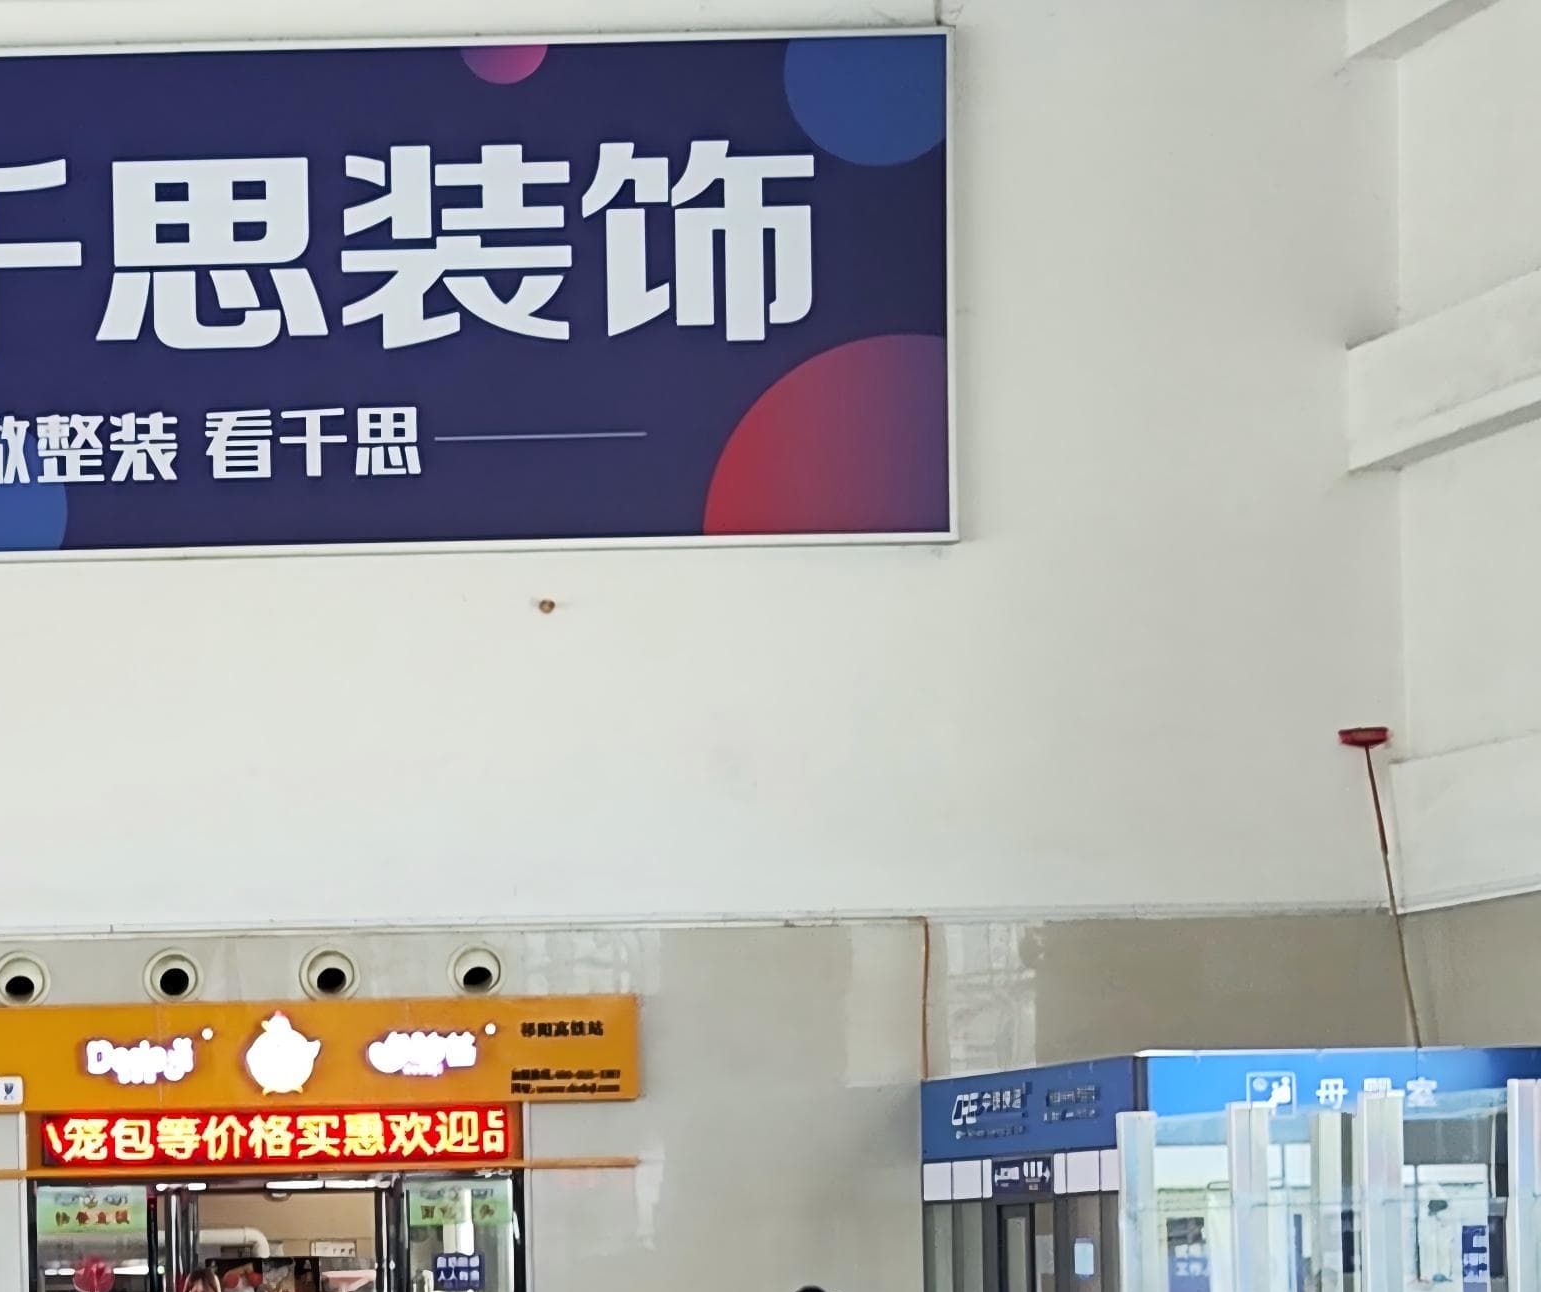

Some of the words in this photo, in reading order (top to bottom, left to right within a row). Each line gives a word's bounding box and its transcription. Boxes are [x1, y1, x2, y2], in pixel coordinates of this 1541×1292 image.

[205, 406, 424, 481] 看千思
[46, 1109, 505, 1161] 笼包等价格实惠欢迎
